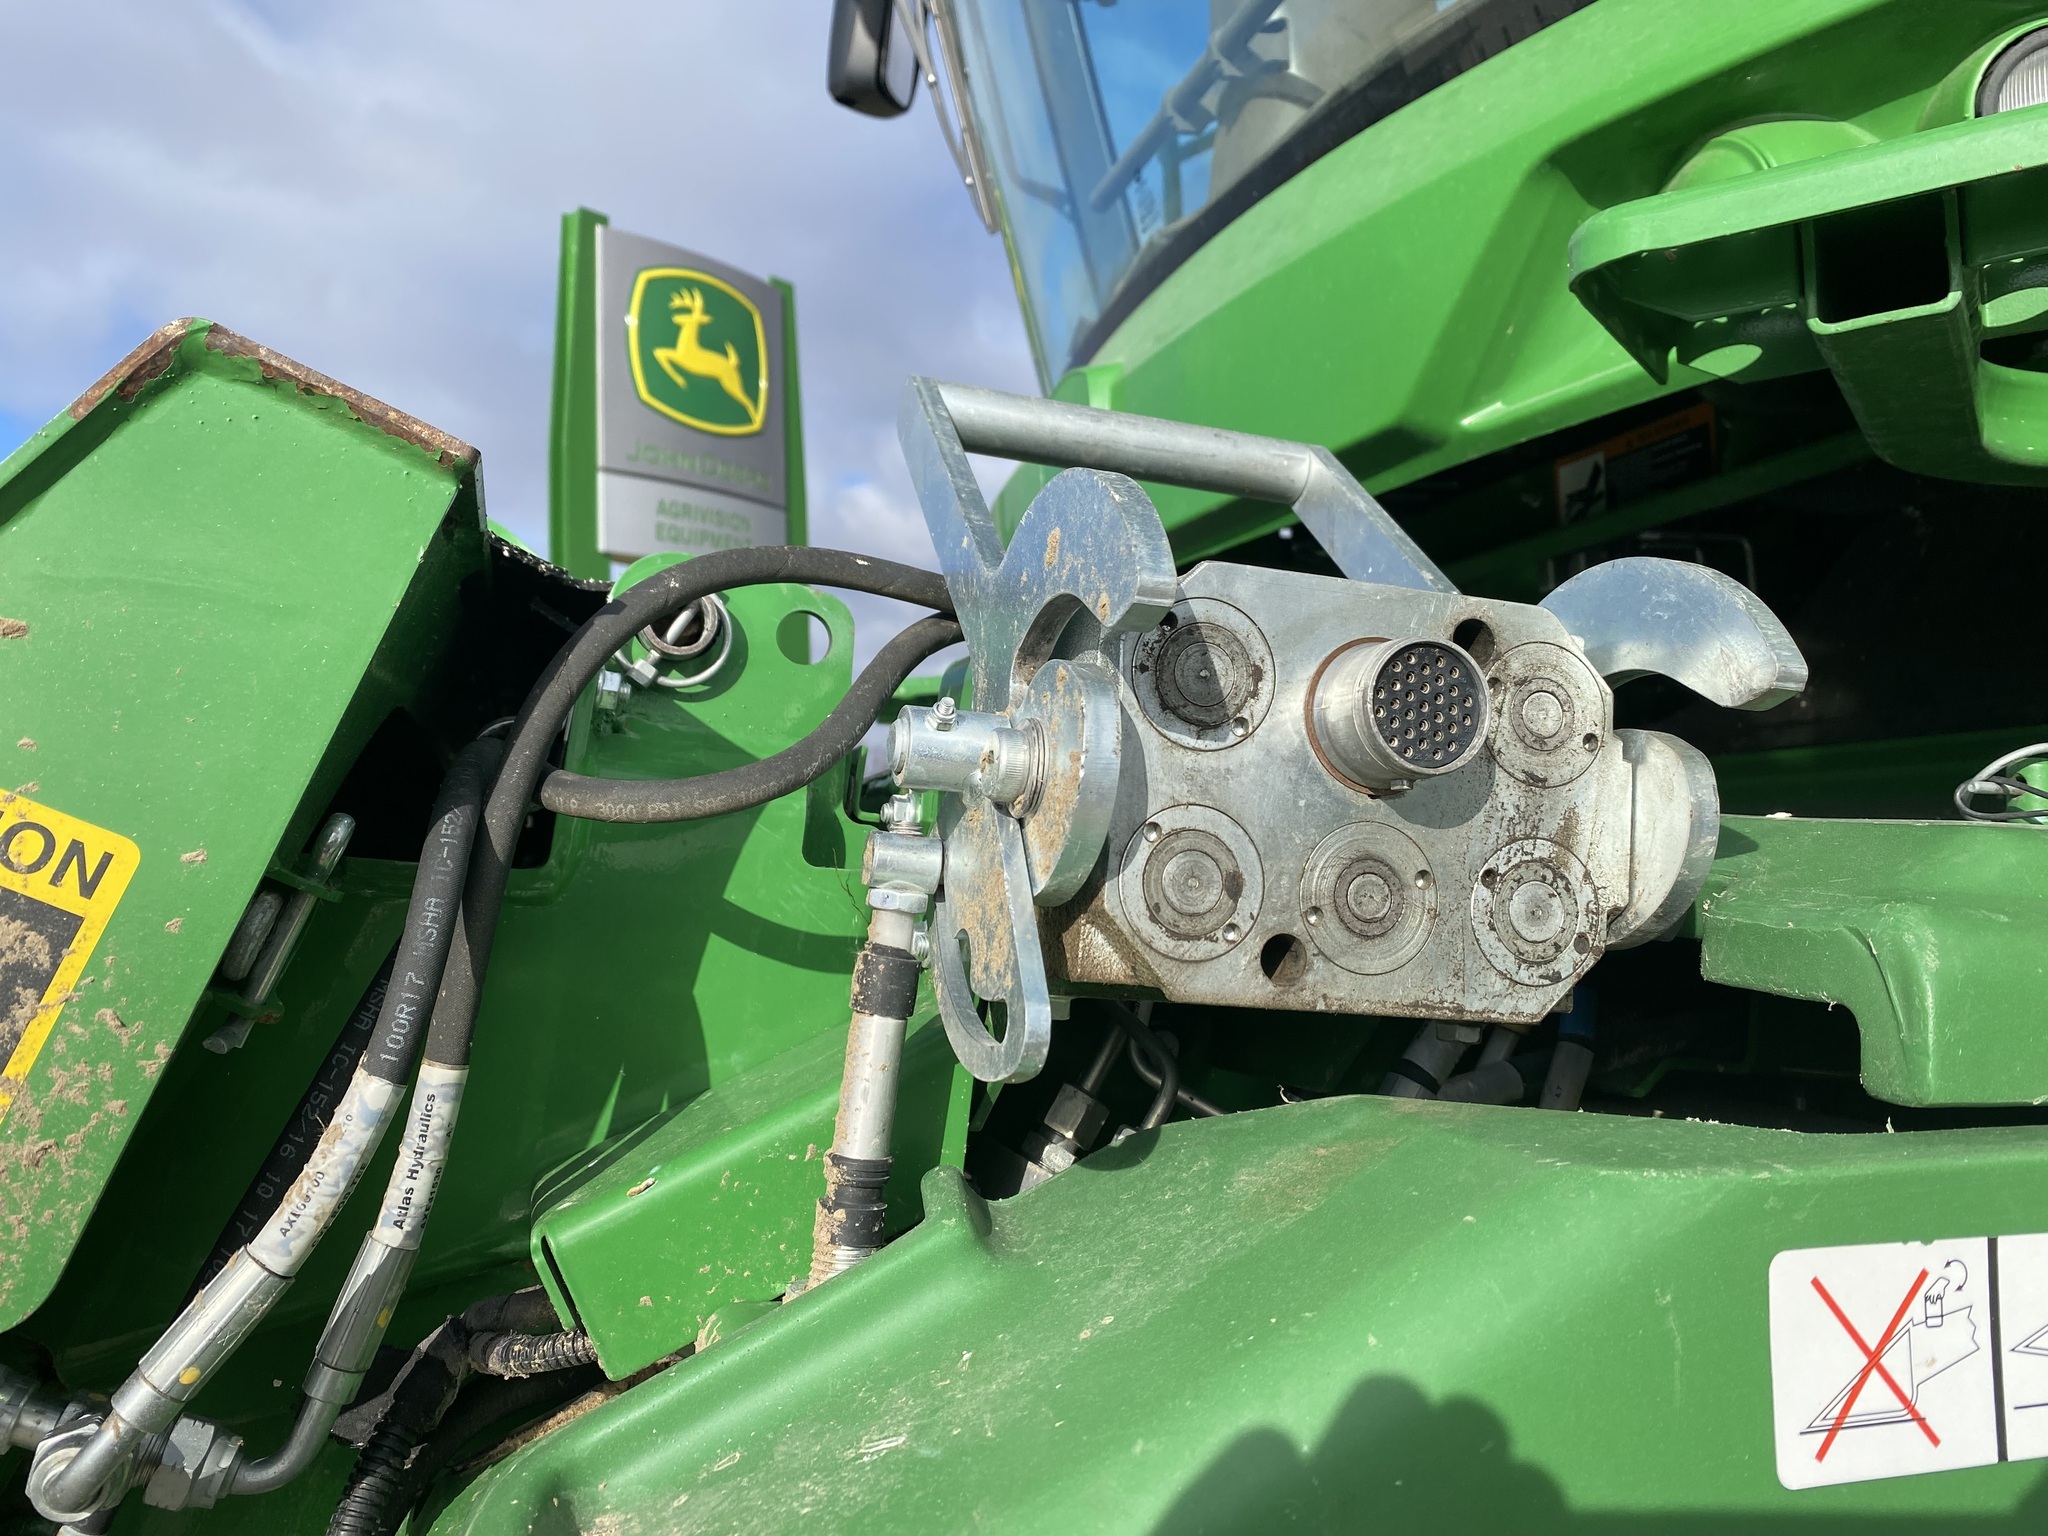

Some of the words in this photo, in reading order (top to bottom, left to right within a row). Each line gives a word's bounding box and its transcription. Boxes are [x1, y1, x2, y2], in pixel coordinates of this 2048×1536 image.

[353, 978, 389, 1031] MSHA
[379, 971, 425, 1062] 100R17
[392, 1187, 415, 1230] Atlas
[406, 1093, 437, 1181] Hydraulics
[235, 1209, 259, 1237] 17
